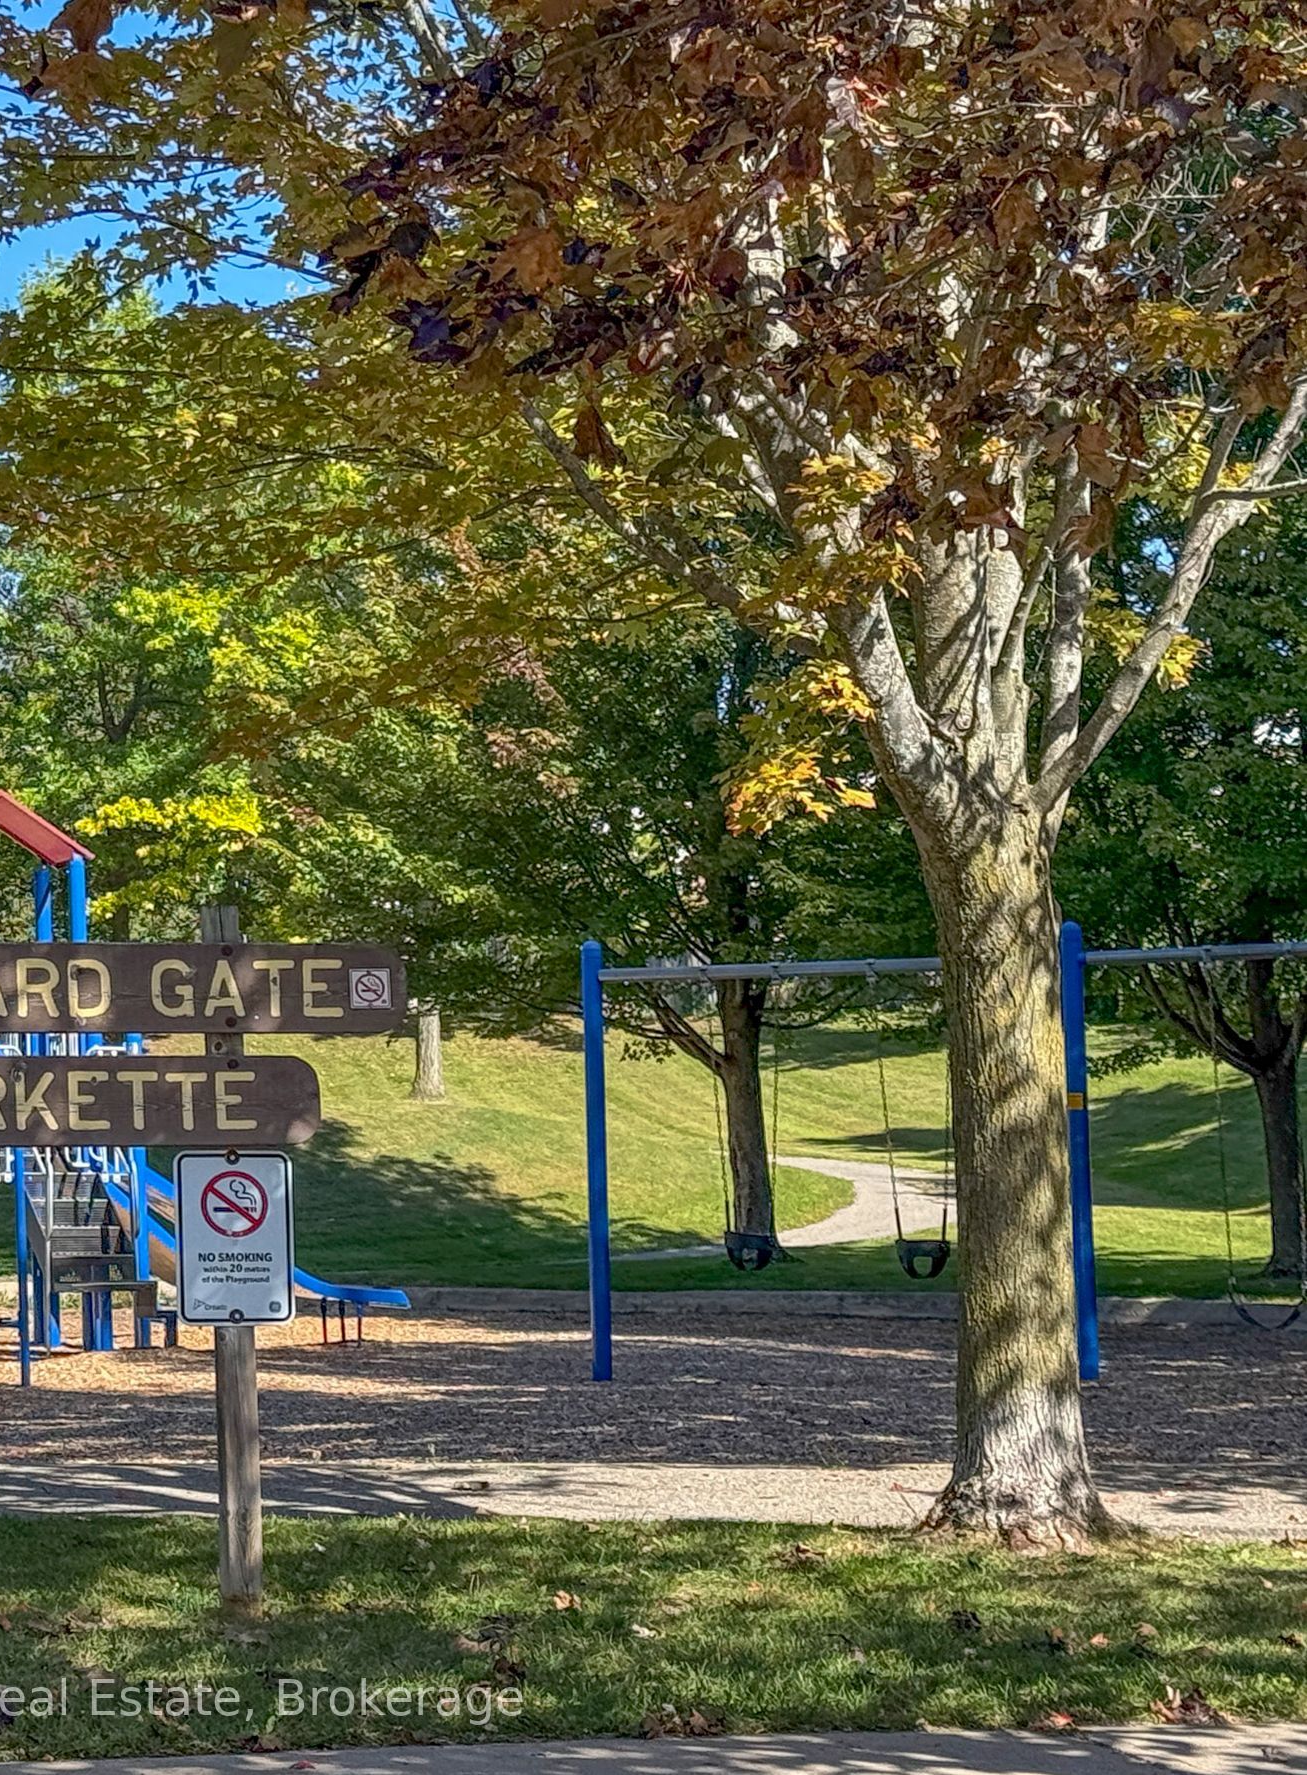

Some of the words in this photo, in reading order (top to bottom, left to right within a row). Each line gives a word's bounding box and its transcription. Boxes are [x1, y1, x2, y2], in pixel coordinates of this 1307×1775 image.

[150, 957, 346, 1019] GATE
[198, 1252, 216, 1262] NO
[218, 1252, 273, 1262] SMOKING
[203, 1265, 228, 1273] within
[229, 1263, 243, 1273] 20
[202, 1275, 210, 1283] of
[211, 1275, 224, 1283] the
[225, 1275, 270, 1284] Playground
